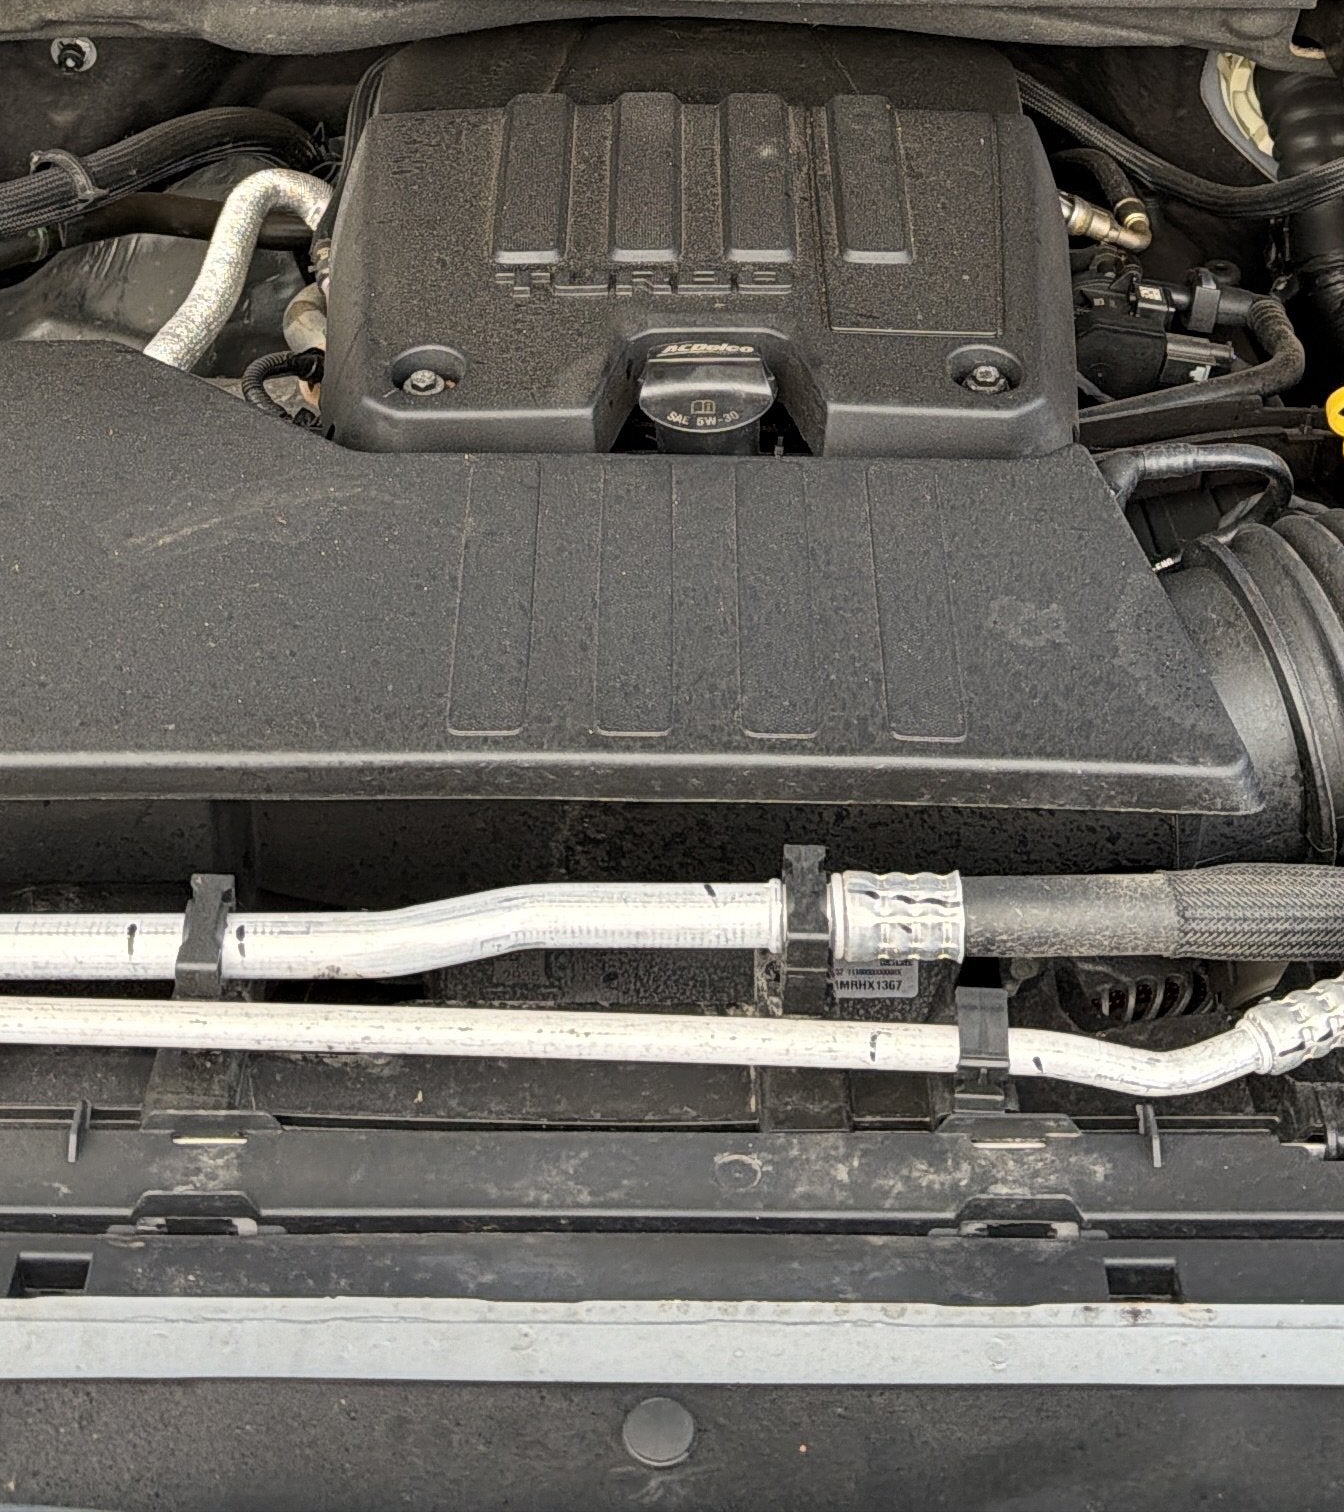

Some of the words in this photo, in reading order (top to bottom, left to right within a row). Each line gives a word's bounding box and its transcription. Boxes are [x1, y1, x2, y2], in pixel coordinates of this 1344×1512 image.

[662, 342, 755, 355] ACDelco
[666, 410, 690, 426] SAE
[696, 410, 740, 426] 5W-30
